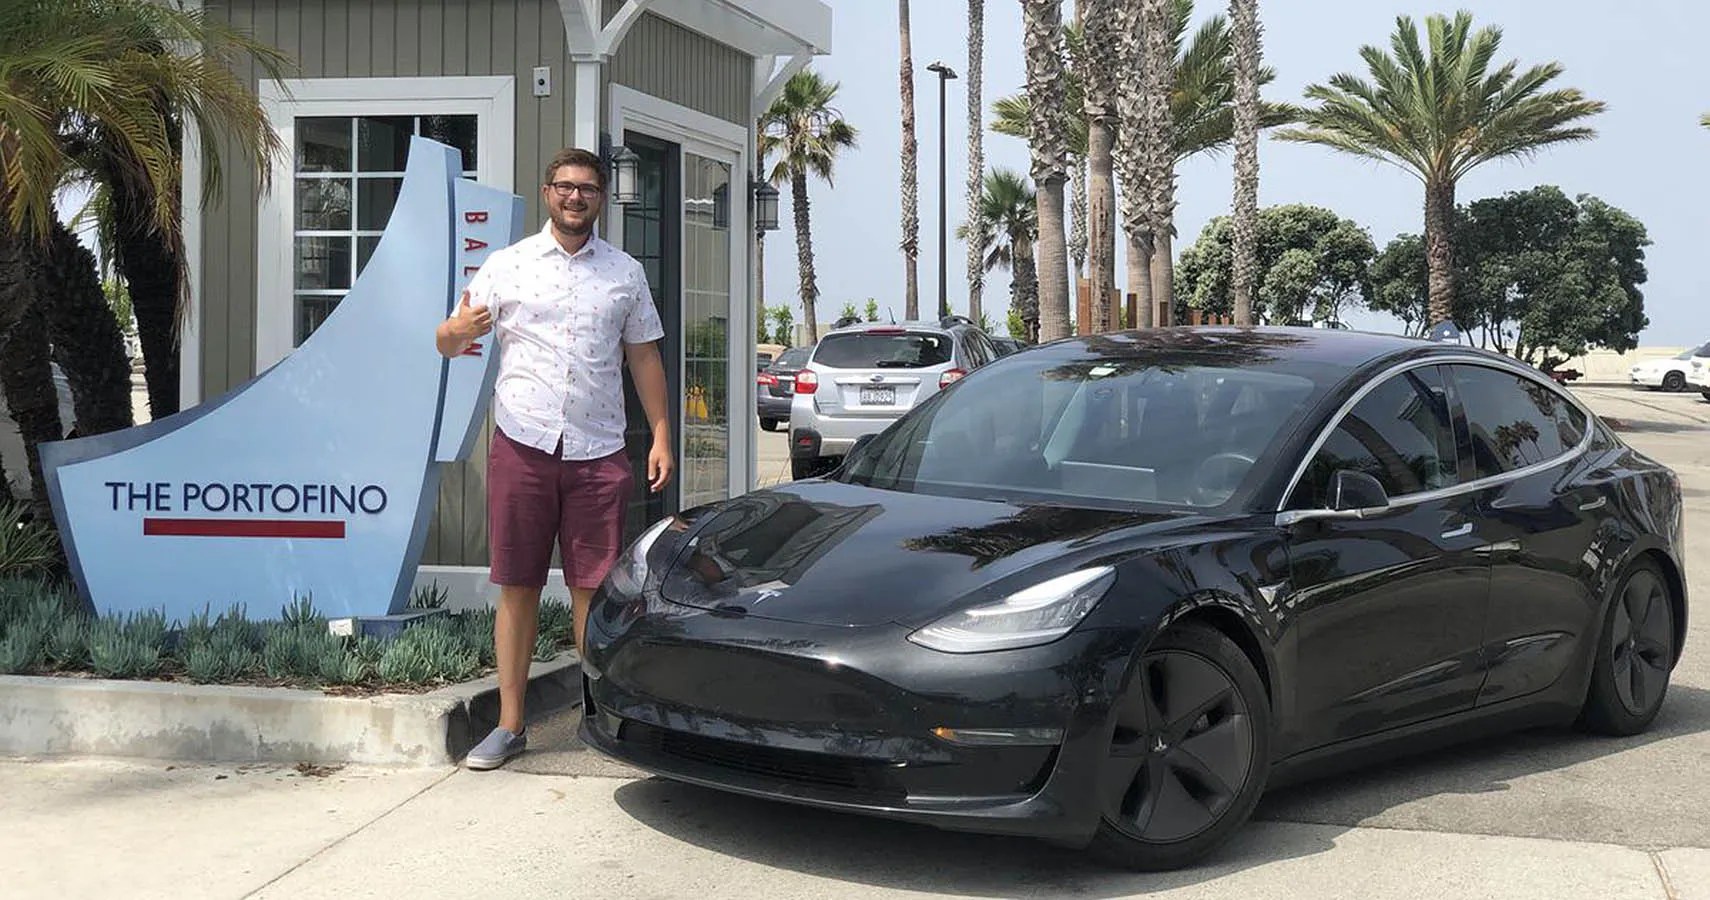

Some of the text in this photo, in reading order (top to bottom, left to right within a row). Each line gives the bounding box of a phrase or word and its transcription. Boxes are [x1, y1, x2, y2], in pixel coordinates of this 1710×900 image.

[463, 211, 488, 357] BALN
[105, 482, 388, 514] THE PORTOFINO
